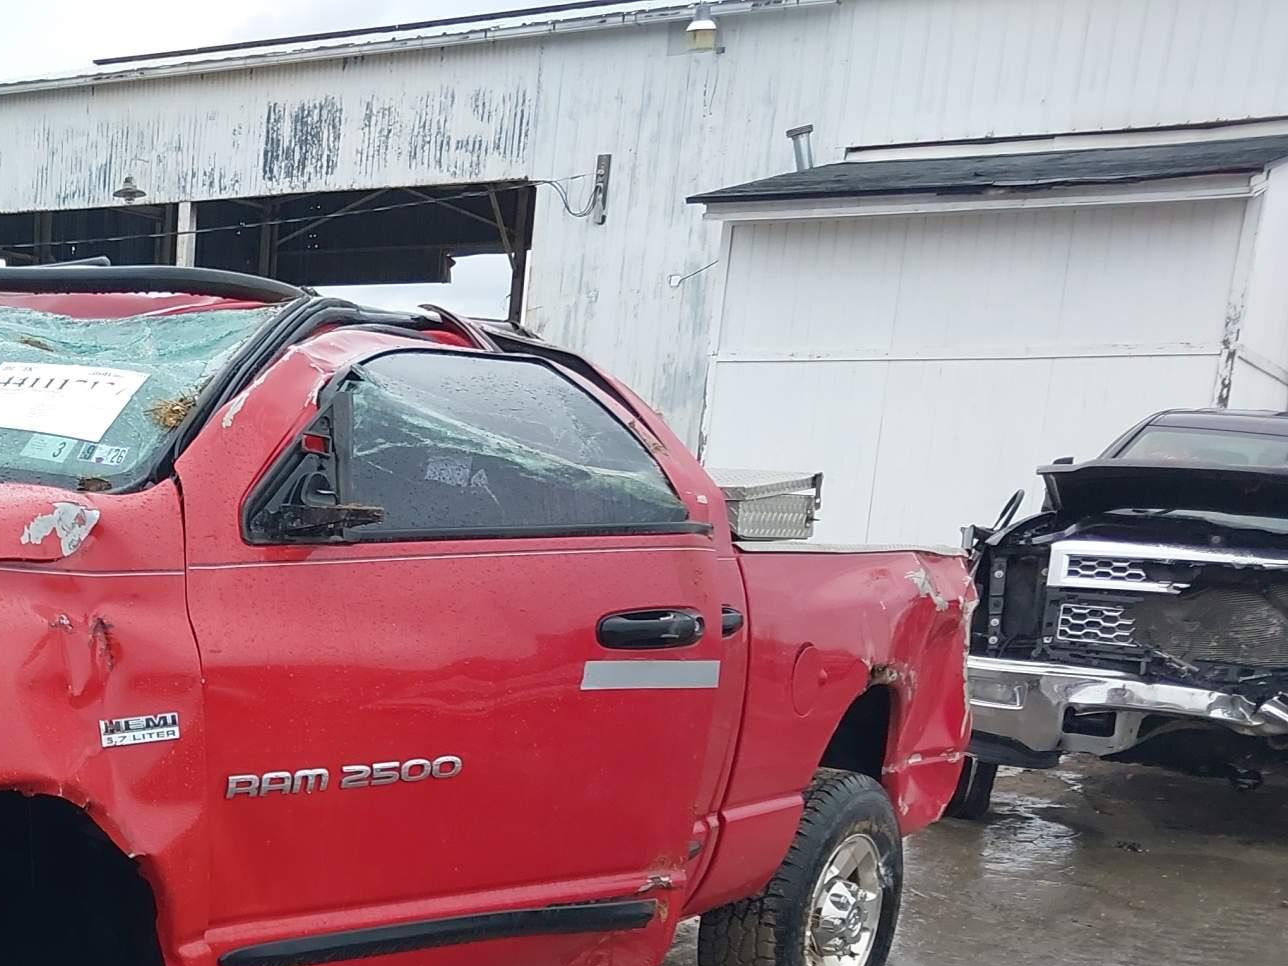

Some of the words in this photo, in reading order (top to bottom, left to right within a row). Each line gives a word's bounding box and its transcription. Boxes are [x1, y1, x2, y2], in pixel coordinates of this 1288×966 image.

[103, 714, 177, 734] HEMI
[132, 729, 176, 741] LITER
[226, 768, 329, 799] RAM
[340, 755, 462, 789] 2500
